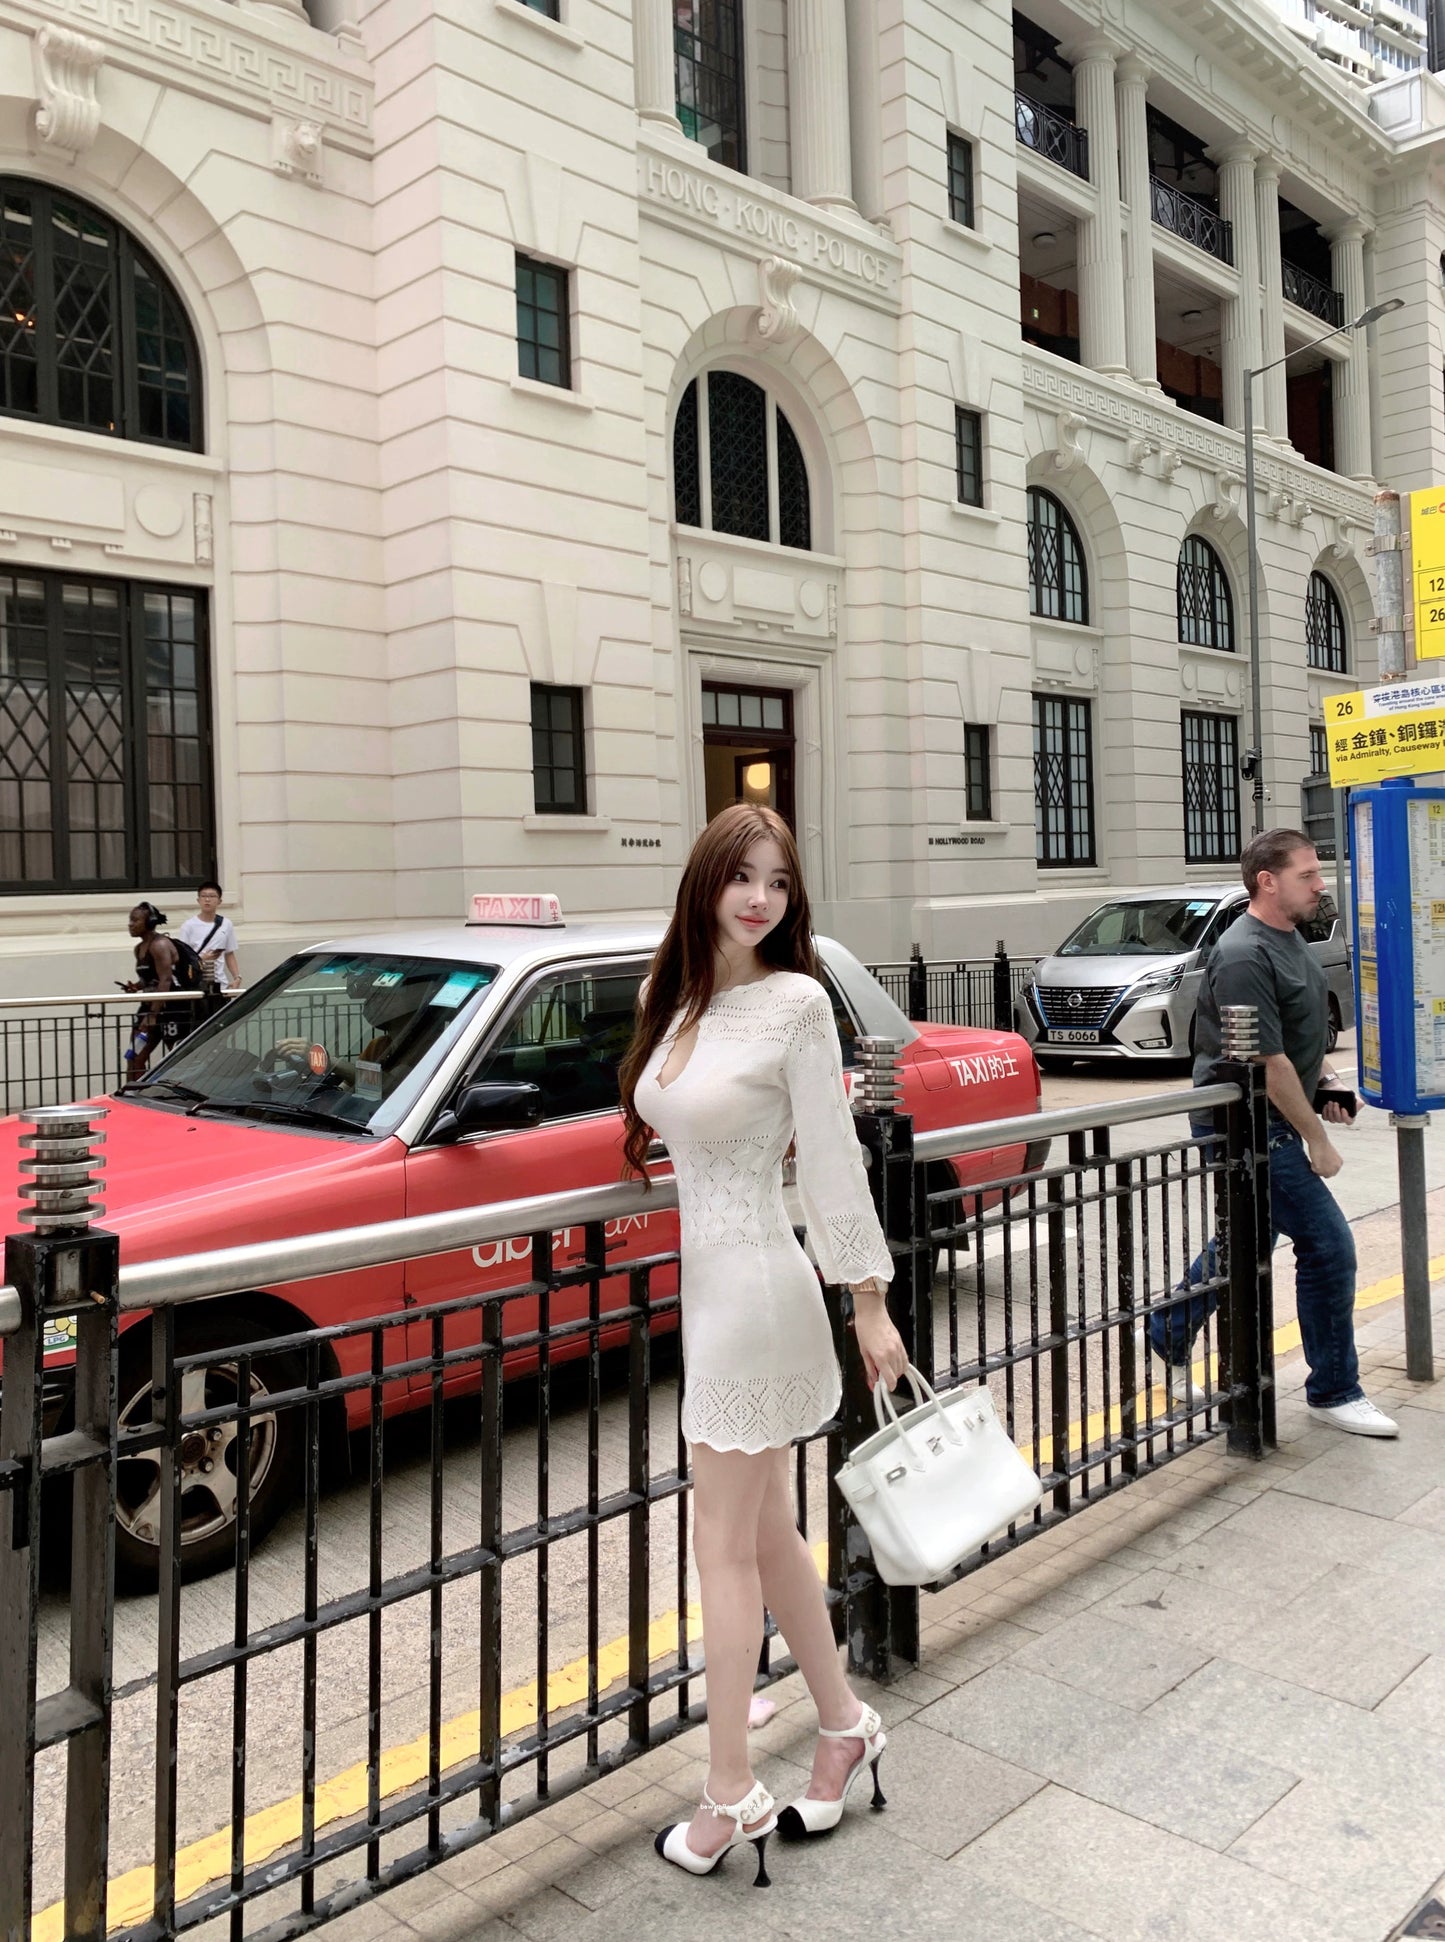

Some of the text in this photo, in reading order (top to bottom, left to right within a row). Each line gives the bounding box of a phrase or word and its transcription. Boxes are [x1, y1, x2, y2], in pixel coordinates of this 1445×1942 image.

[647, 158, 890, 290] HONG KONG POLICE
[1336, 700, 1353, 717] 26
[1335, 738, 1348, 753] 經
[1350, 748, 1392, 761] Admiralty,
[1393, 741, 1441, 754] Causeway
[1432, 804, 1441, 814] 12
[935, 837, 969, 845] HOLLYWOOD
[970, 836, 986, 845] ROAD
[474, 897, 541, 920] TAXI
[549, 900, 559, 921] 的士
[1050, 1031, 1097, 1041] TS 6066
[309, 1050, 328, 1067] TAXI
[47, 1335, 66, 1345] LPG
[740, 1791, 769, 1822] CHA
